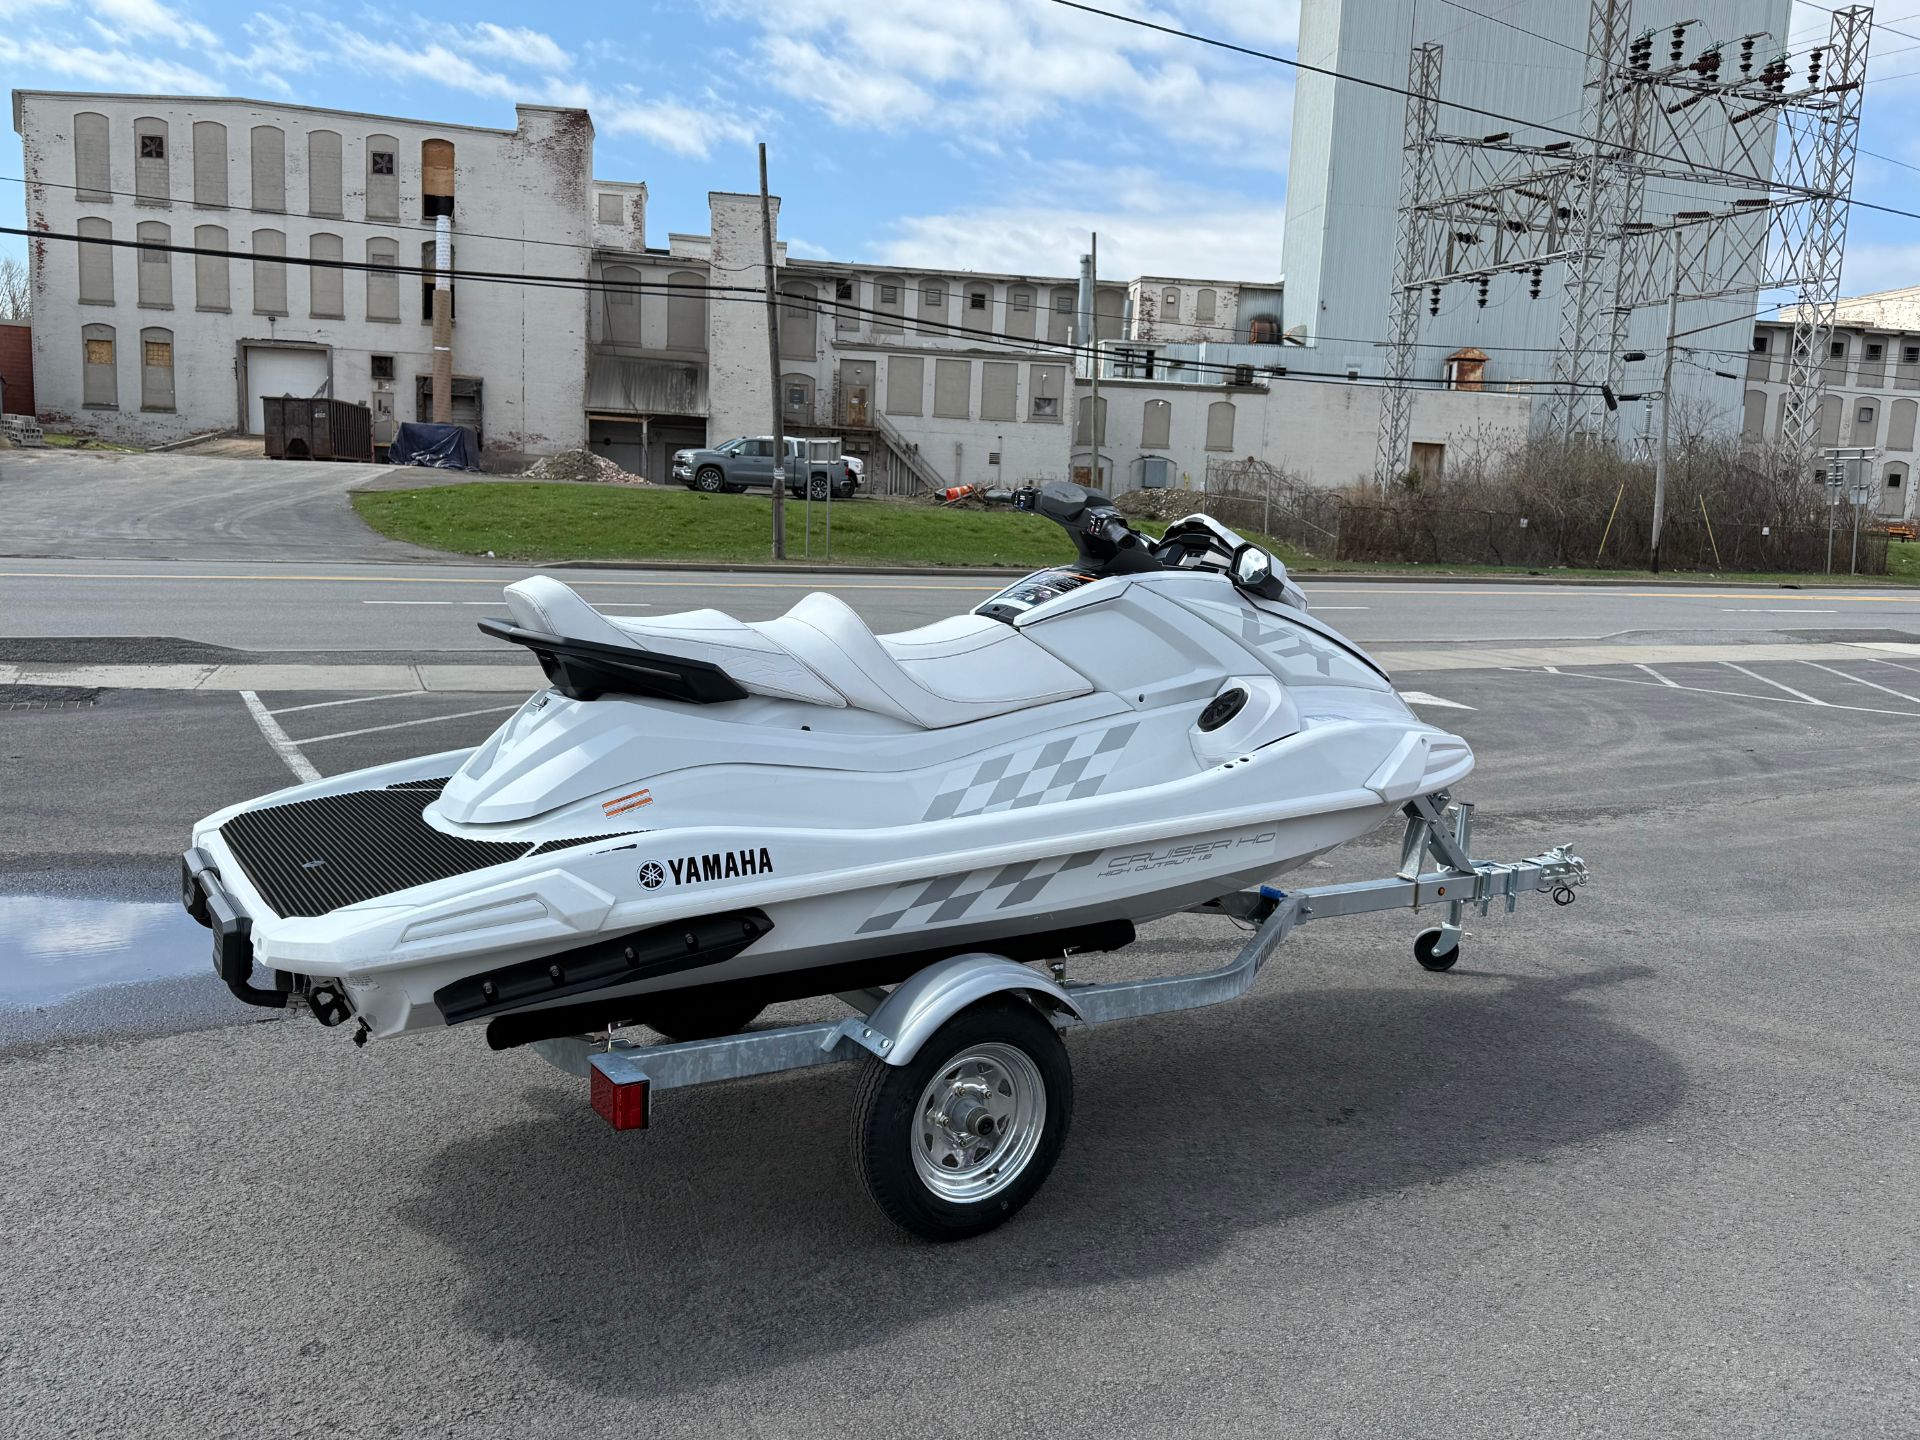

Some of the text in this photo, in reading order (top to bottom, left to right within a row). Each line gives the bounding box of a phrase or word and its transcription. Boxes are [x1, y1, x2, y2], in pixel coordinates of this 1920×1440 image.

[1240, 607, 1342, 677] VX
[667, 847, 774, 886] YAMAHA
[1097, 867, 1131, 878] HIGH
[1134, 856, 1195, 872] OUTPUT
[1107, 832, 1277, 868] CRUISER HO
